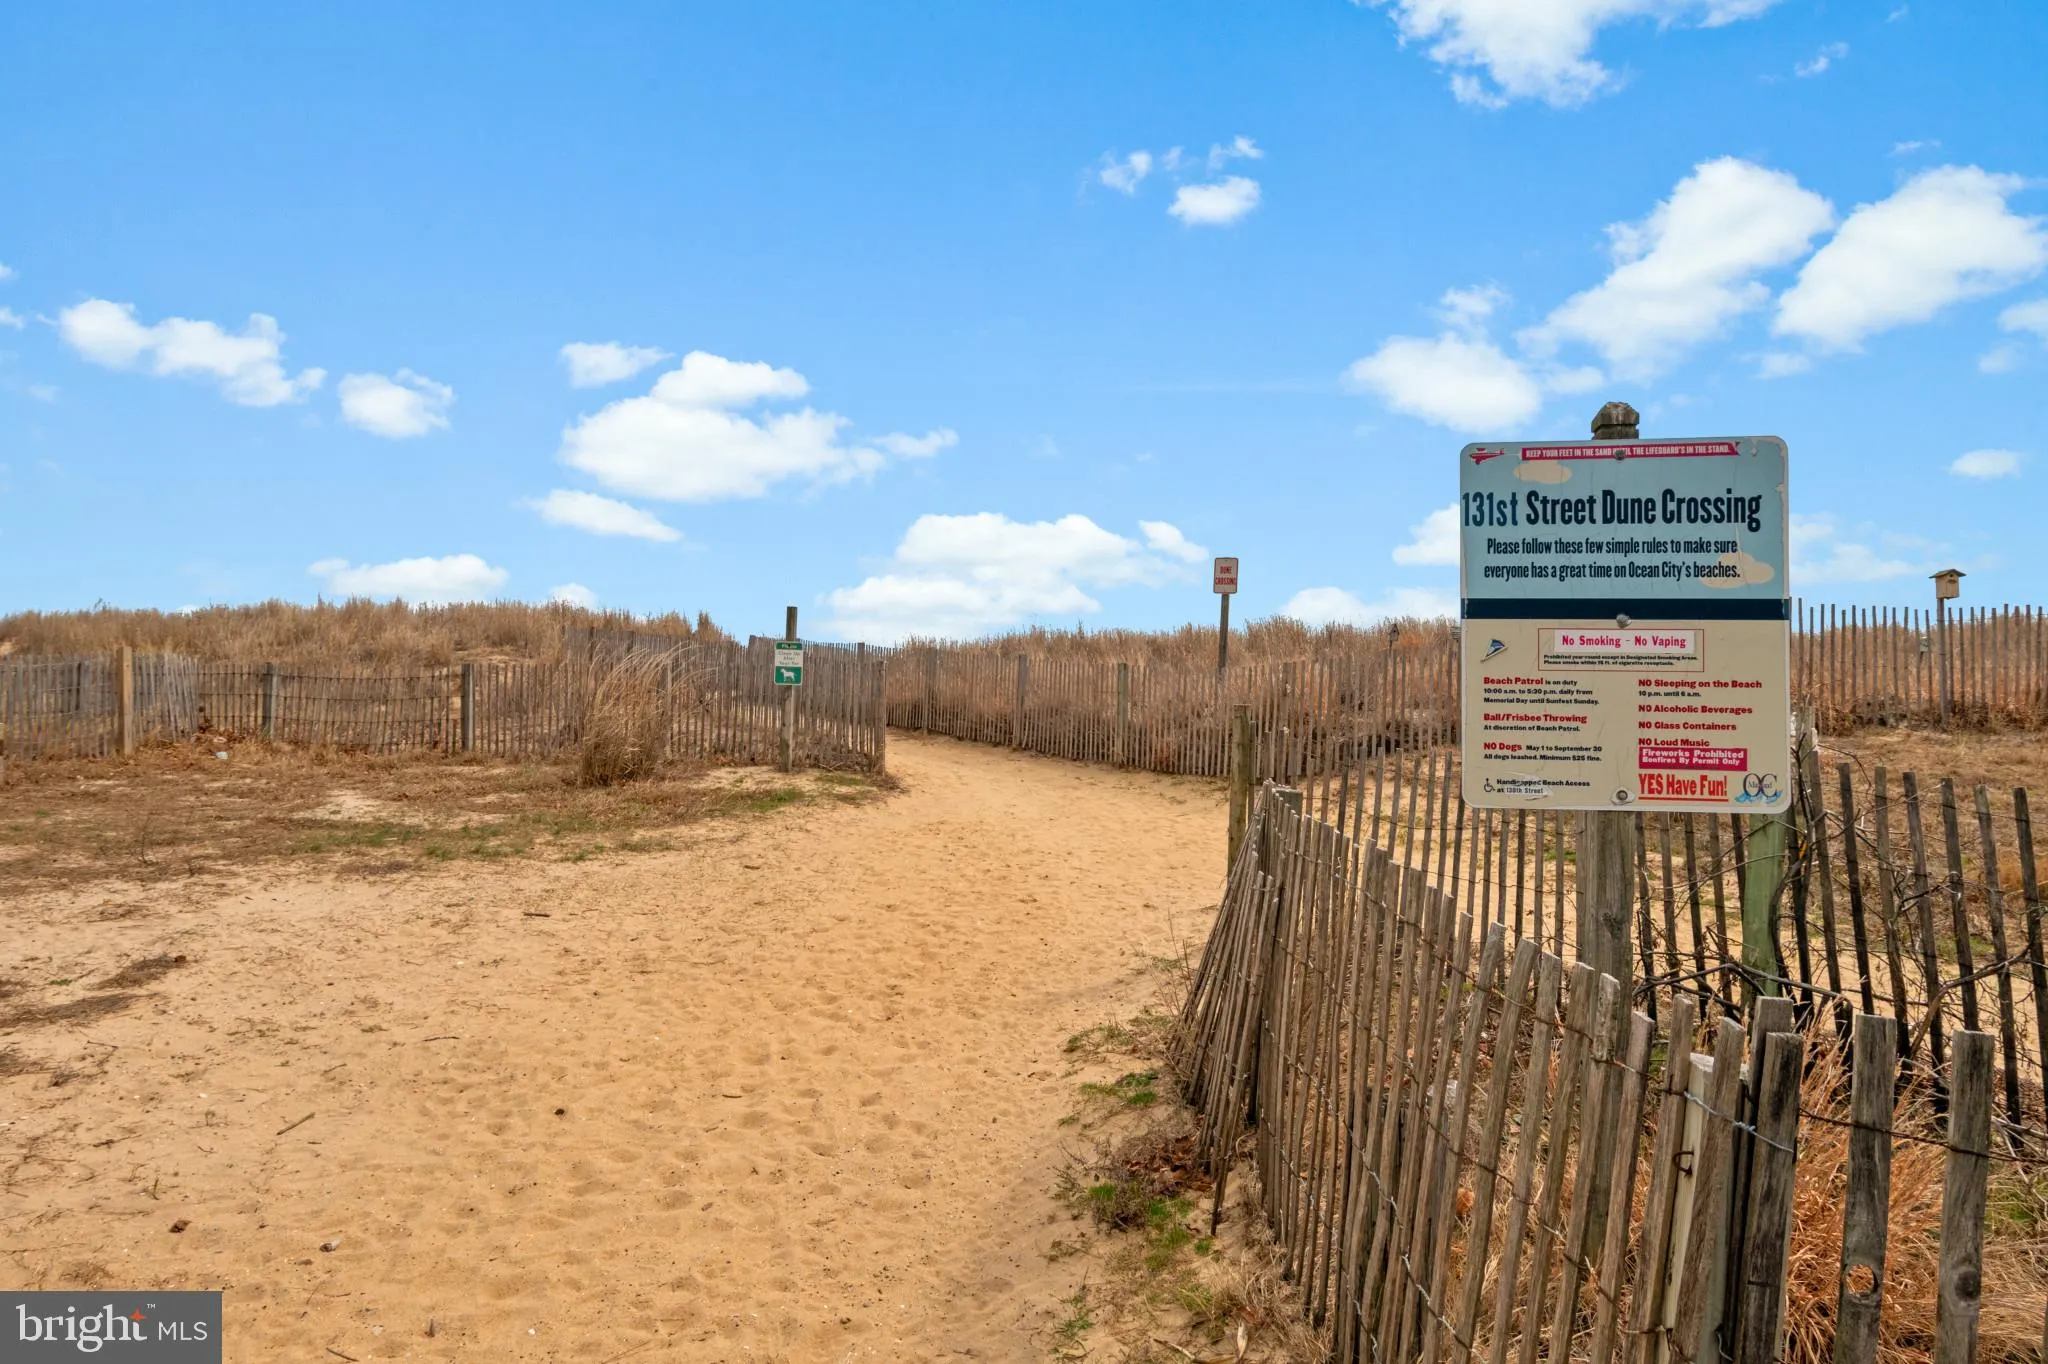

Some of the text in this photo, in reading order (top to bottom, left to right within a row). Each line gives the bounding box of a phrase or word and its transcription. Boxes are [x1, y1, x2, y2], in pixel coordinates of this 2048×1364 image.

[1526, 450, 1540, 458] KEEP
[1595, 448, 1612, 456] SAND
[1462, 488, 1762, 532] 131st Street Dune Crossing
[1487, 537, 1738, 557] Please follow these few simple rules to make sure
[1484, 561, 1740, 582] everyone has a great time on Ocean City's beaches.
[1562, 635, 1574, 646] No
[1579, 635, 1621, 648] Smoking
[1634, 636, 1647, 646] No
[1652, 636, 1686, 648] Vaping
[1654, 680, 1696, 688] Sleeping
[1701, 706, 1752, 715] Beverages
[1543, 714, 1587, 724] Throwing
[1499, 743, 1522, 752] Dogs
[1638, 774, 1727, 796] YES Have Fun!
[1743, 773, 1777, 798] OC
